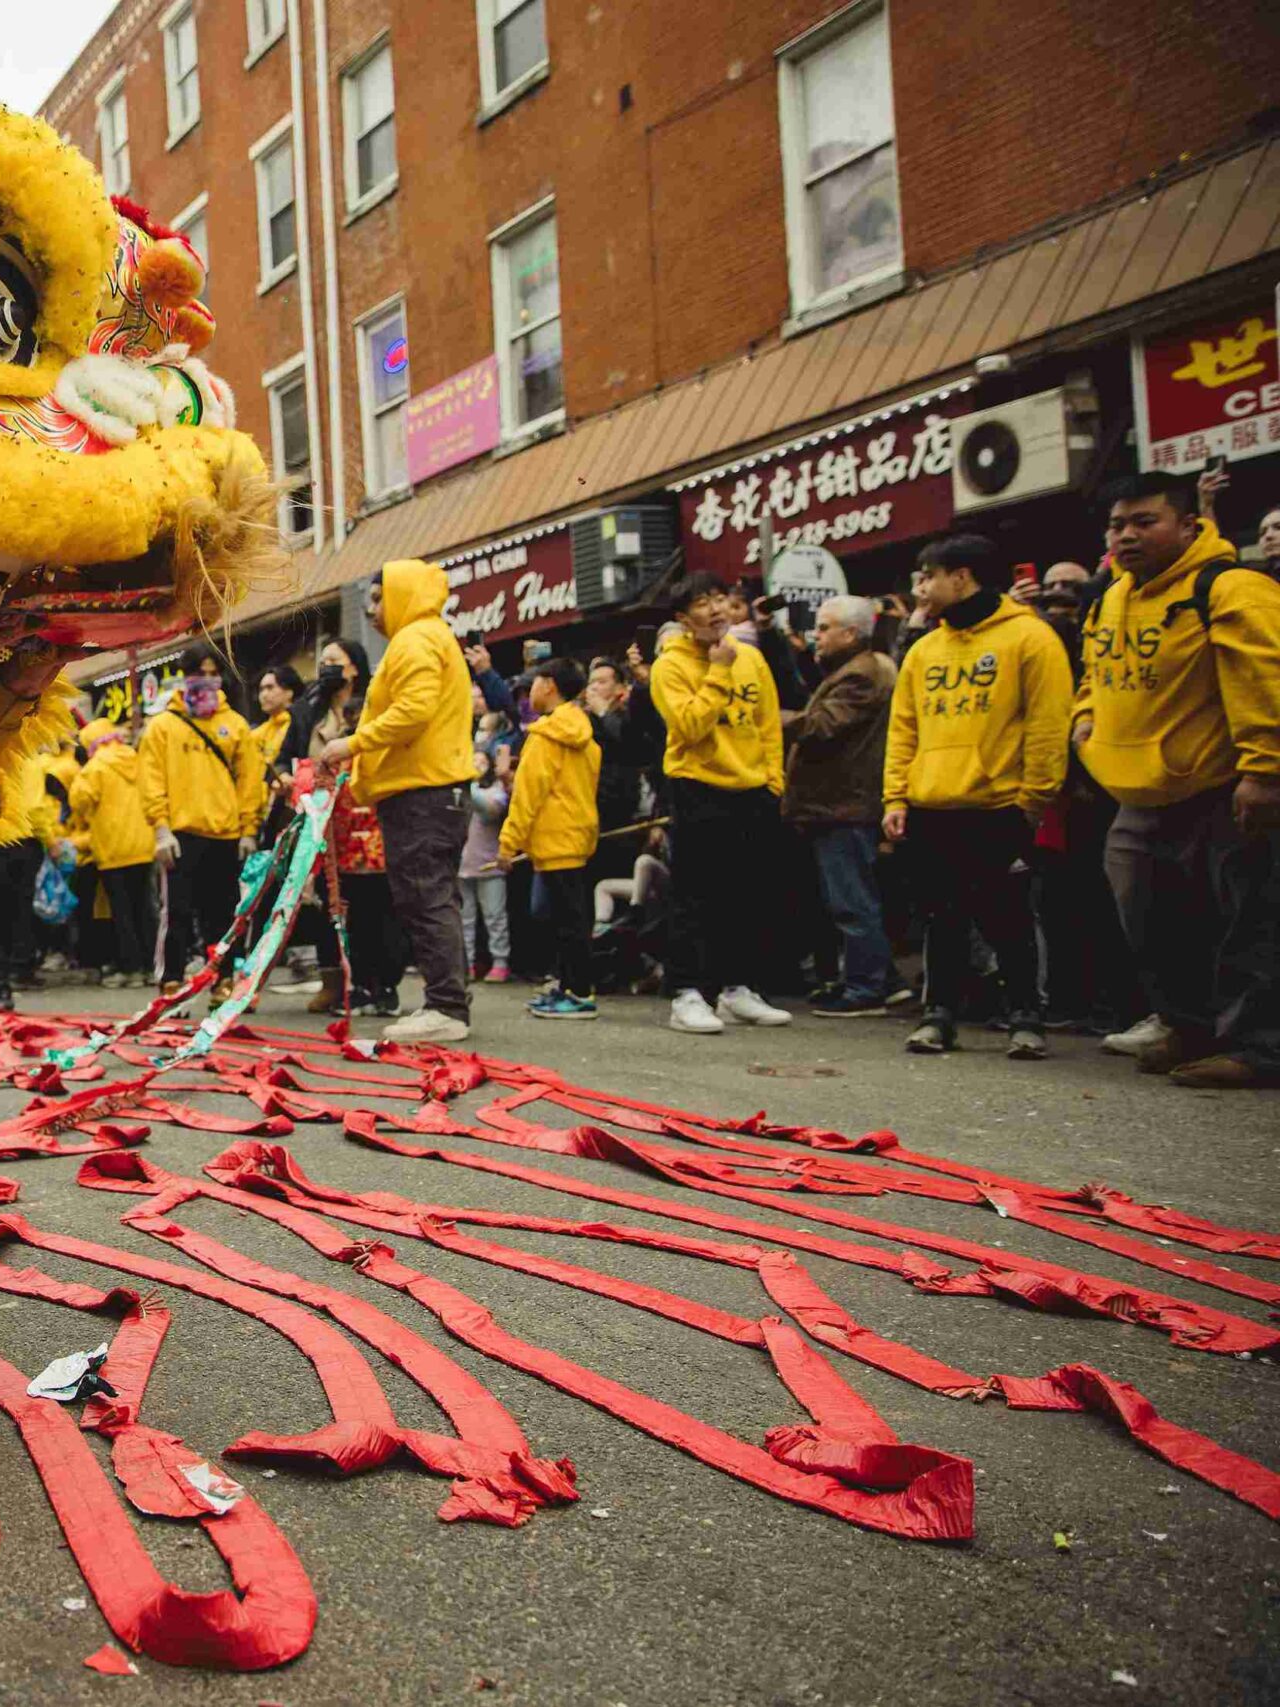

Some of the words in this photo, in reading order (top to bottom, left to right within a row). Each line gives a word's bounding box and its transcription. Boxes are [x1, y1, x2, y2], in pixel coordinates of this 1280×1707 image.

[441, 590, 506, 637] Sweet
[514, 571, 578, 622] Hous
[1095, 627, 1160, 659] SUNS
[926, 663, 997, 691] SUNS
